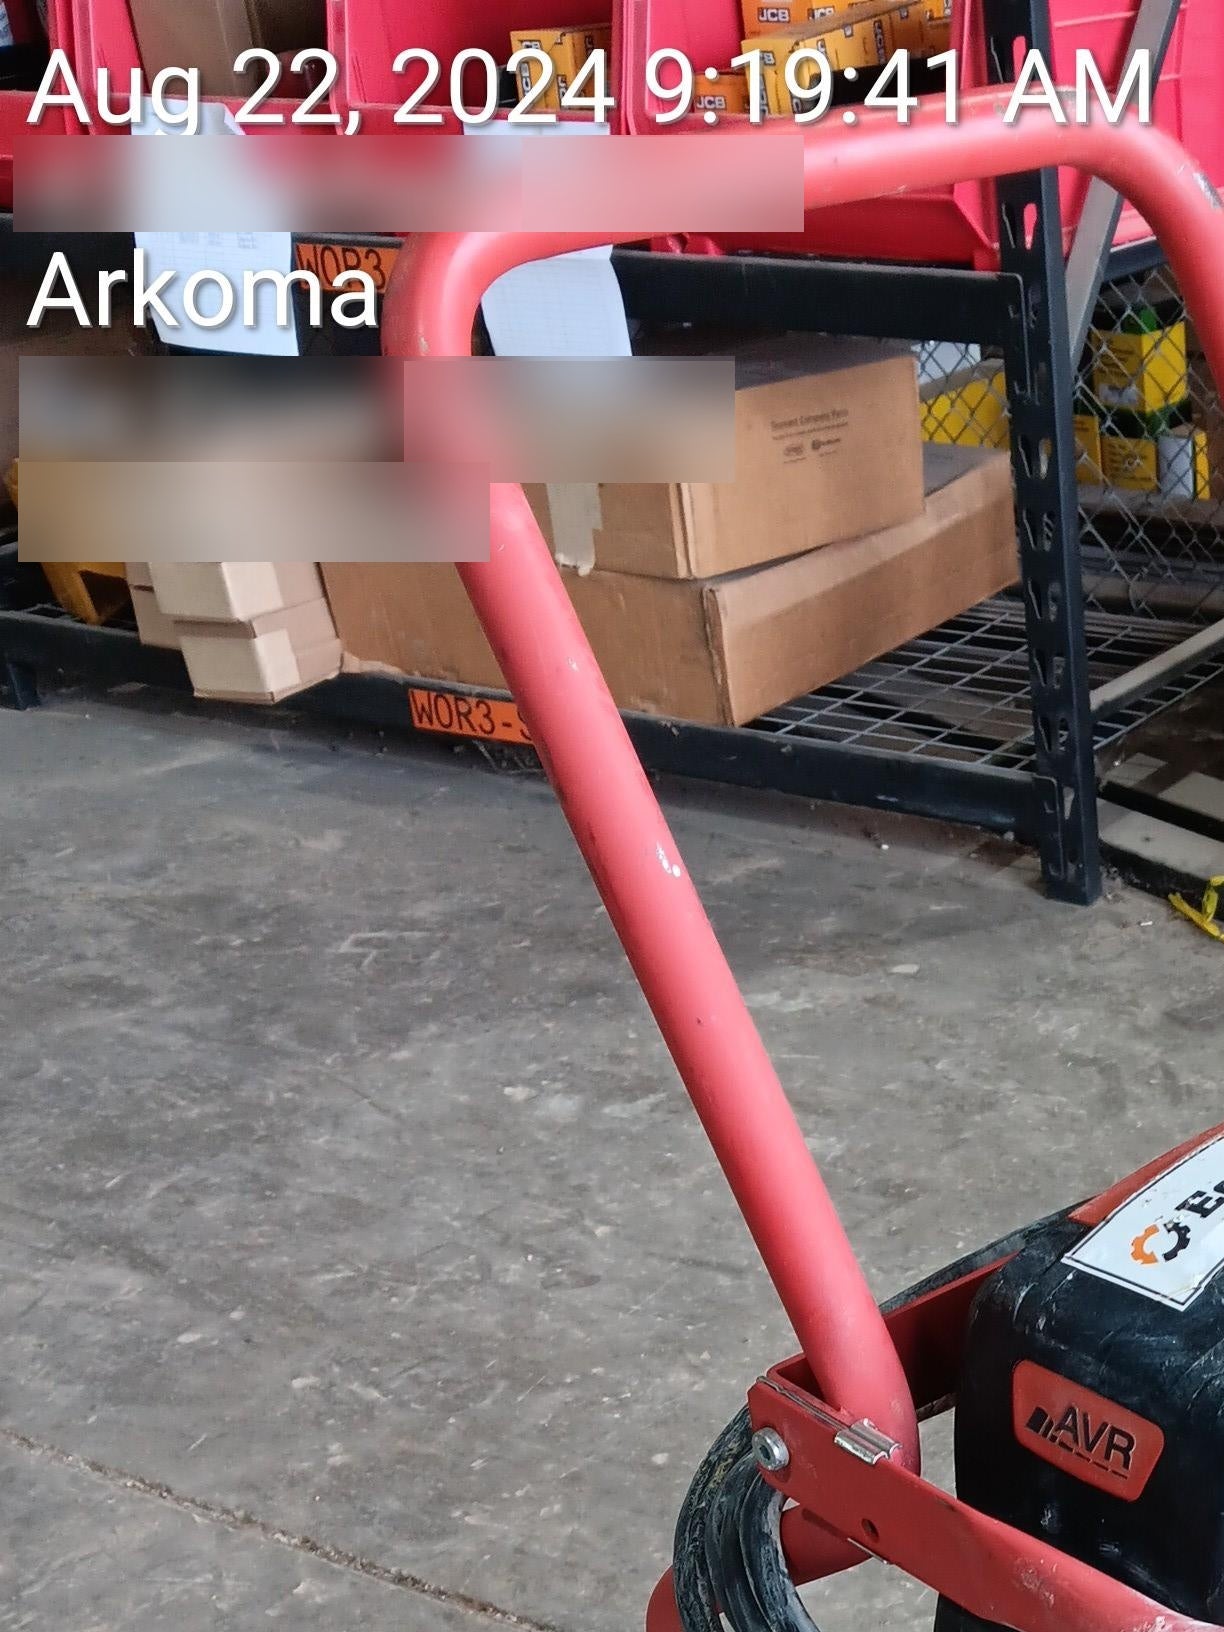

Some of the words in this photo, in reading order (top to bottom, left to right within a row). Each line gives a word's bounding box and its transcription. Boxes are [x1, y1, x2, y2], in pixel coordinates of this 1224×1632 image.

[757, 7, 790, 22] JCB
[696, 95, 728, 109] JCB
[1054, 1403, 1137, 1471] AVR
